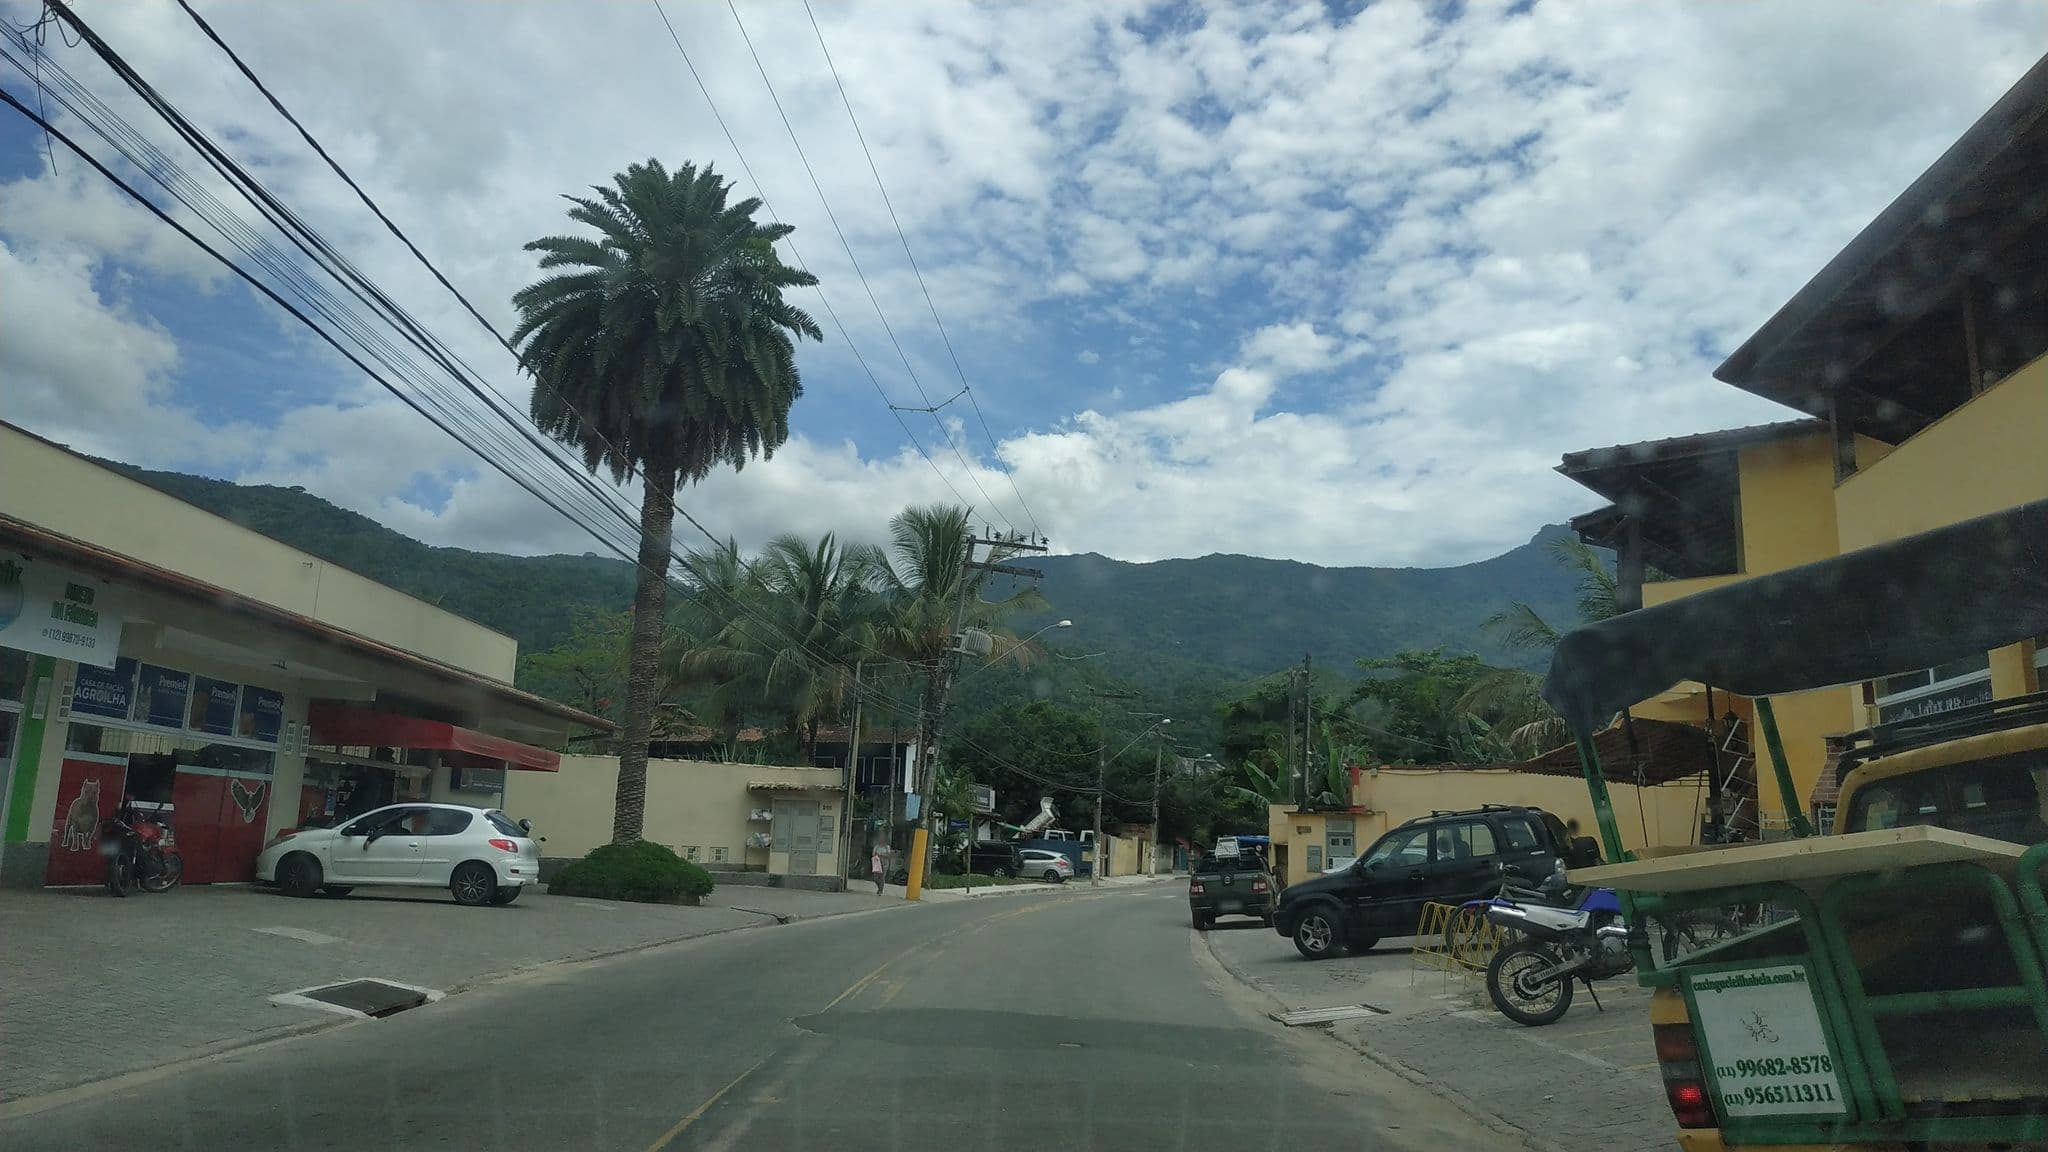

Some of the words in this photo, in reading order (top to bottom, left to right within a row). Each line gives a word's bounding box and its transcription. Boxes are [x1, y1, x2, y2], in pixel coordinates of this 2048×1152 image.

[74, 686, 127, 706] AGROILHA
[1717, 1066, 1736, 1079] (11)
[1736, 1055, 1832, 1077] 99682-8578
[1725, 1094, 1744, 1106] (11)
[1744, 1083, 1835, 1105] 956511311
